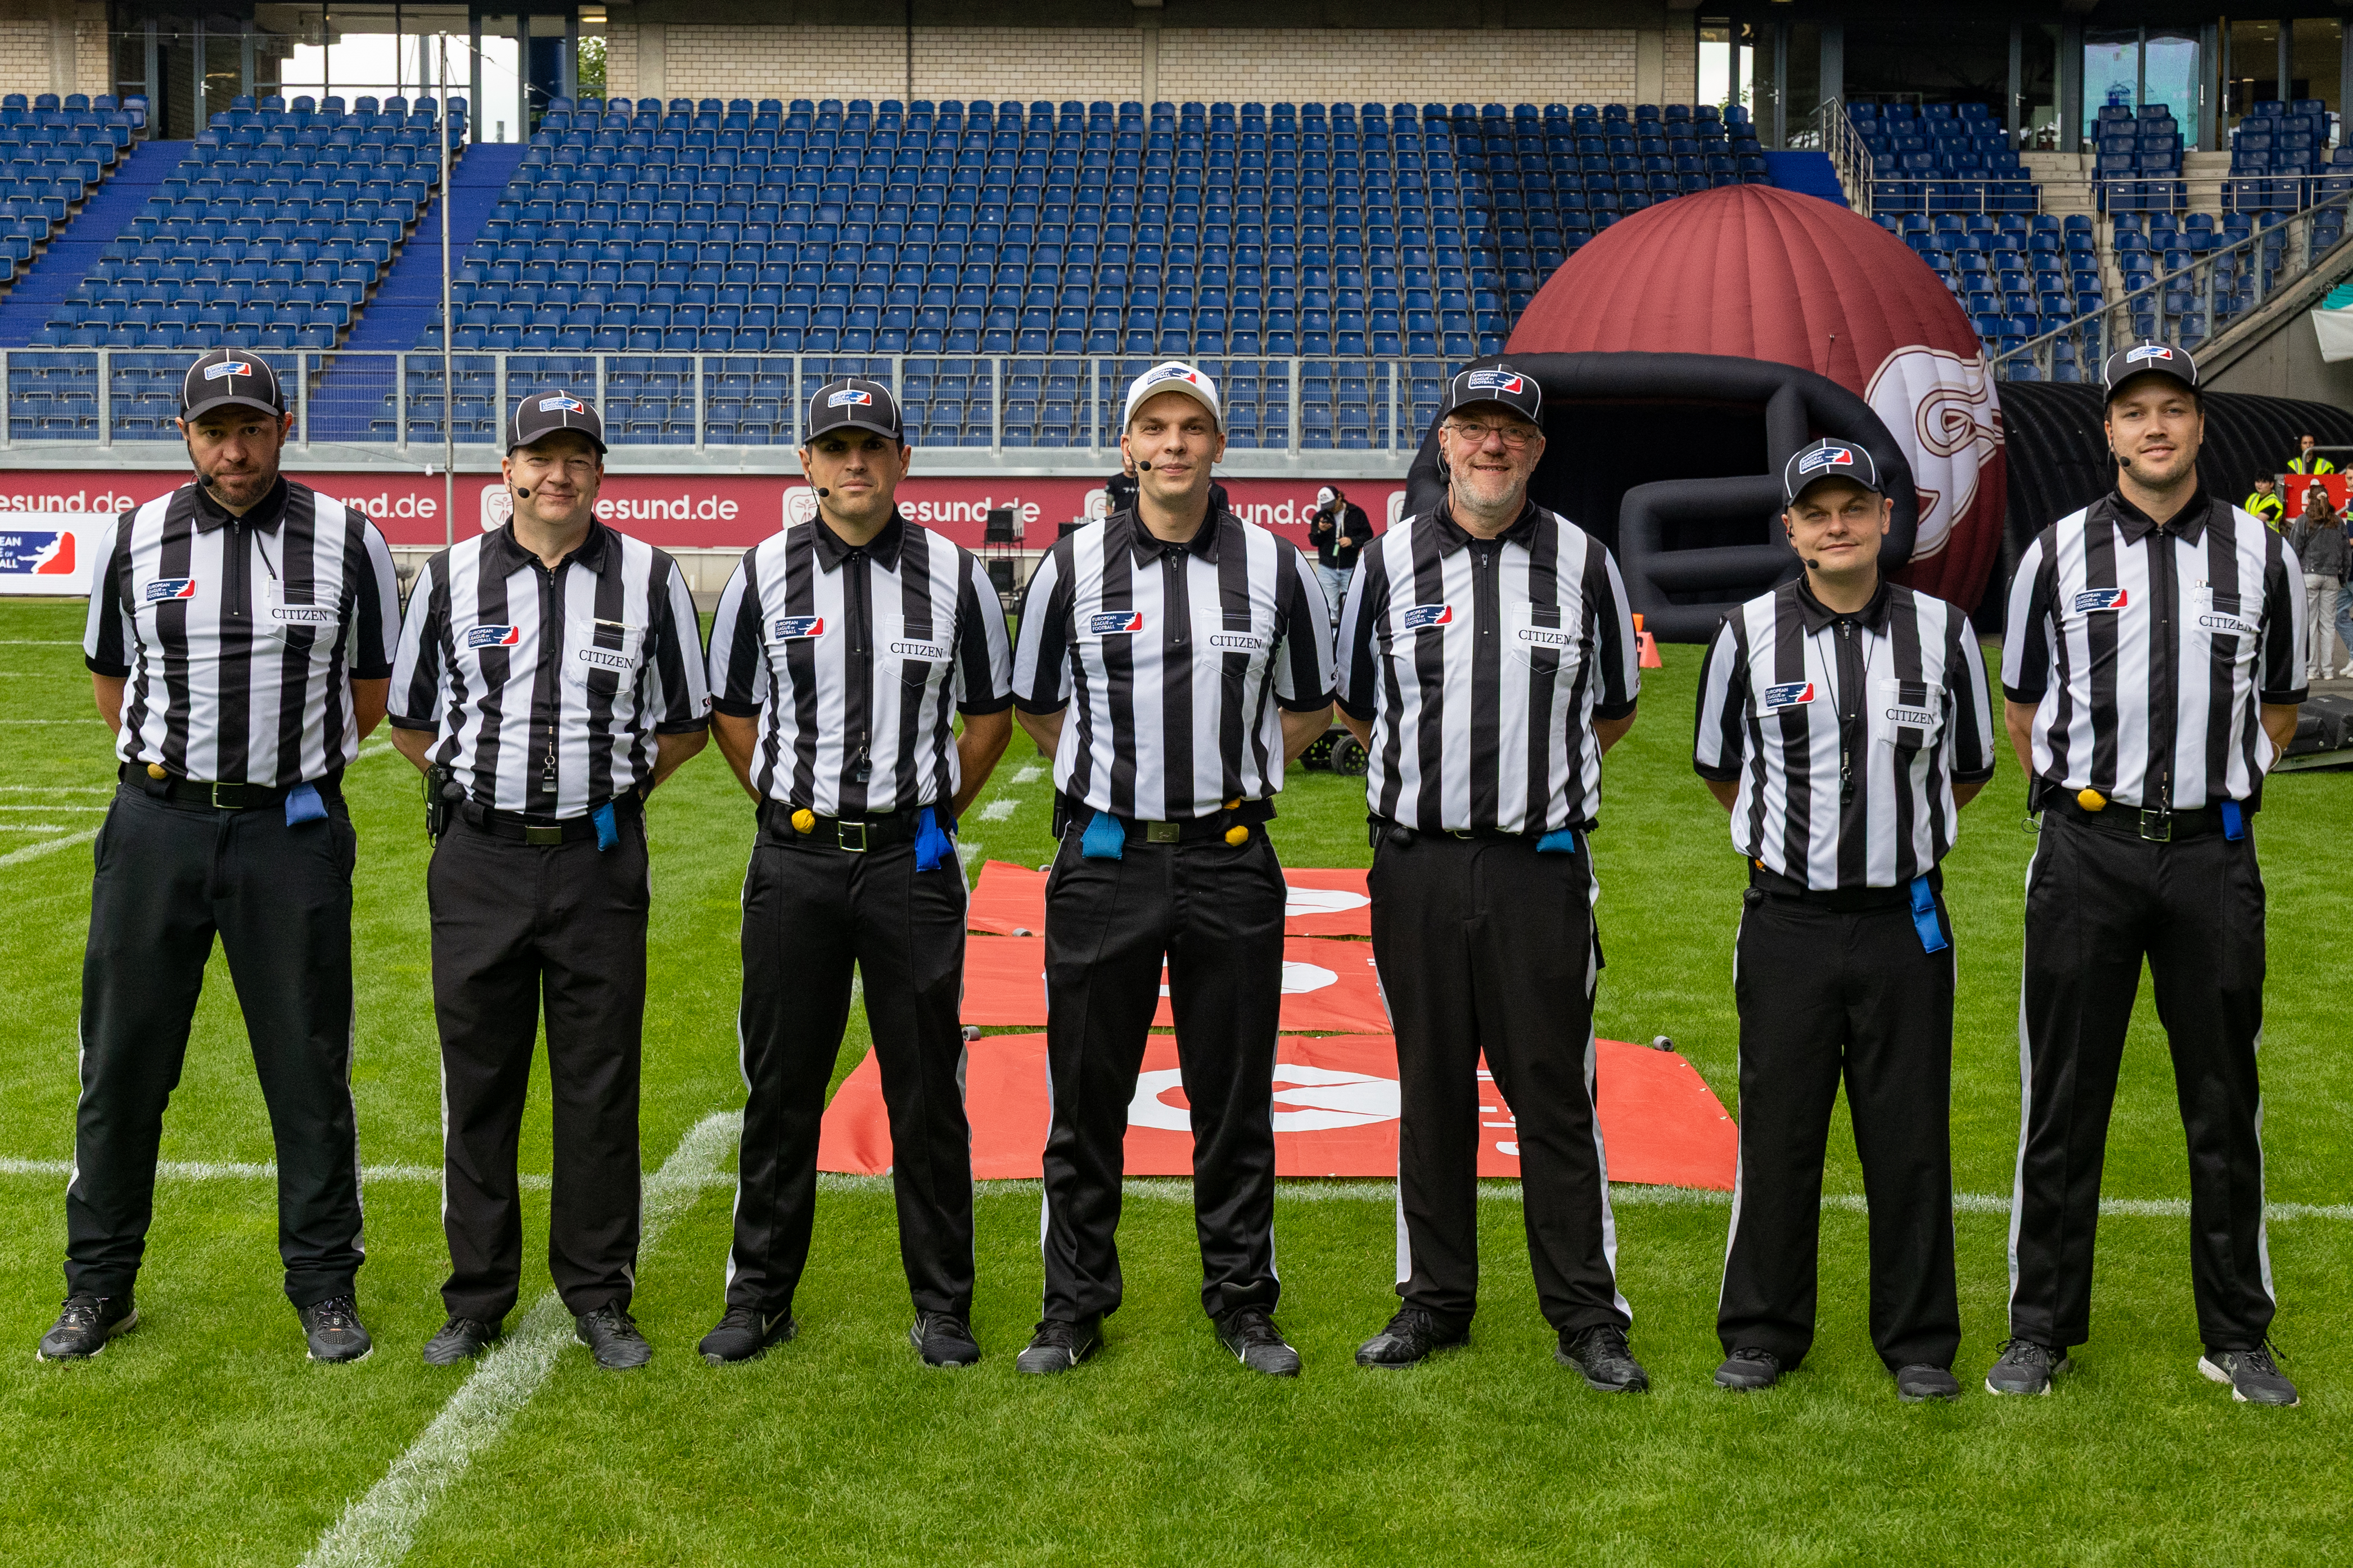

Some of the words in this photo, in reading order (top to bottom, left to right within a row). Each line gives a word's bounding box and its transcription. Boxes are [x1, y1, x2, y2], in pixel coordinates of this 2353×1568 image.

[272, 608, 328, 621] CITIZEN
[1406, 609, 1427, 617] EUROPEAN
[1406, 618, 1426, 626] FOOTBALL
[1210, 635, 1262, 649] CITIZEN
[1518, 630, 1572, 645] CITIZEN
[890, 642, 944, 658] CITIZEN
[579, 649, 634, 669] CITIZEN
[1886, 708, 1935, 725] CITIZEN
